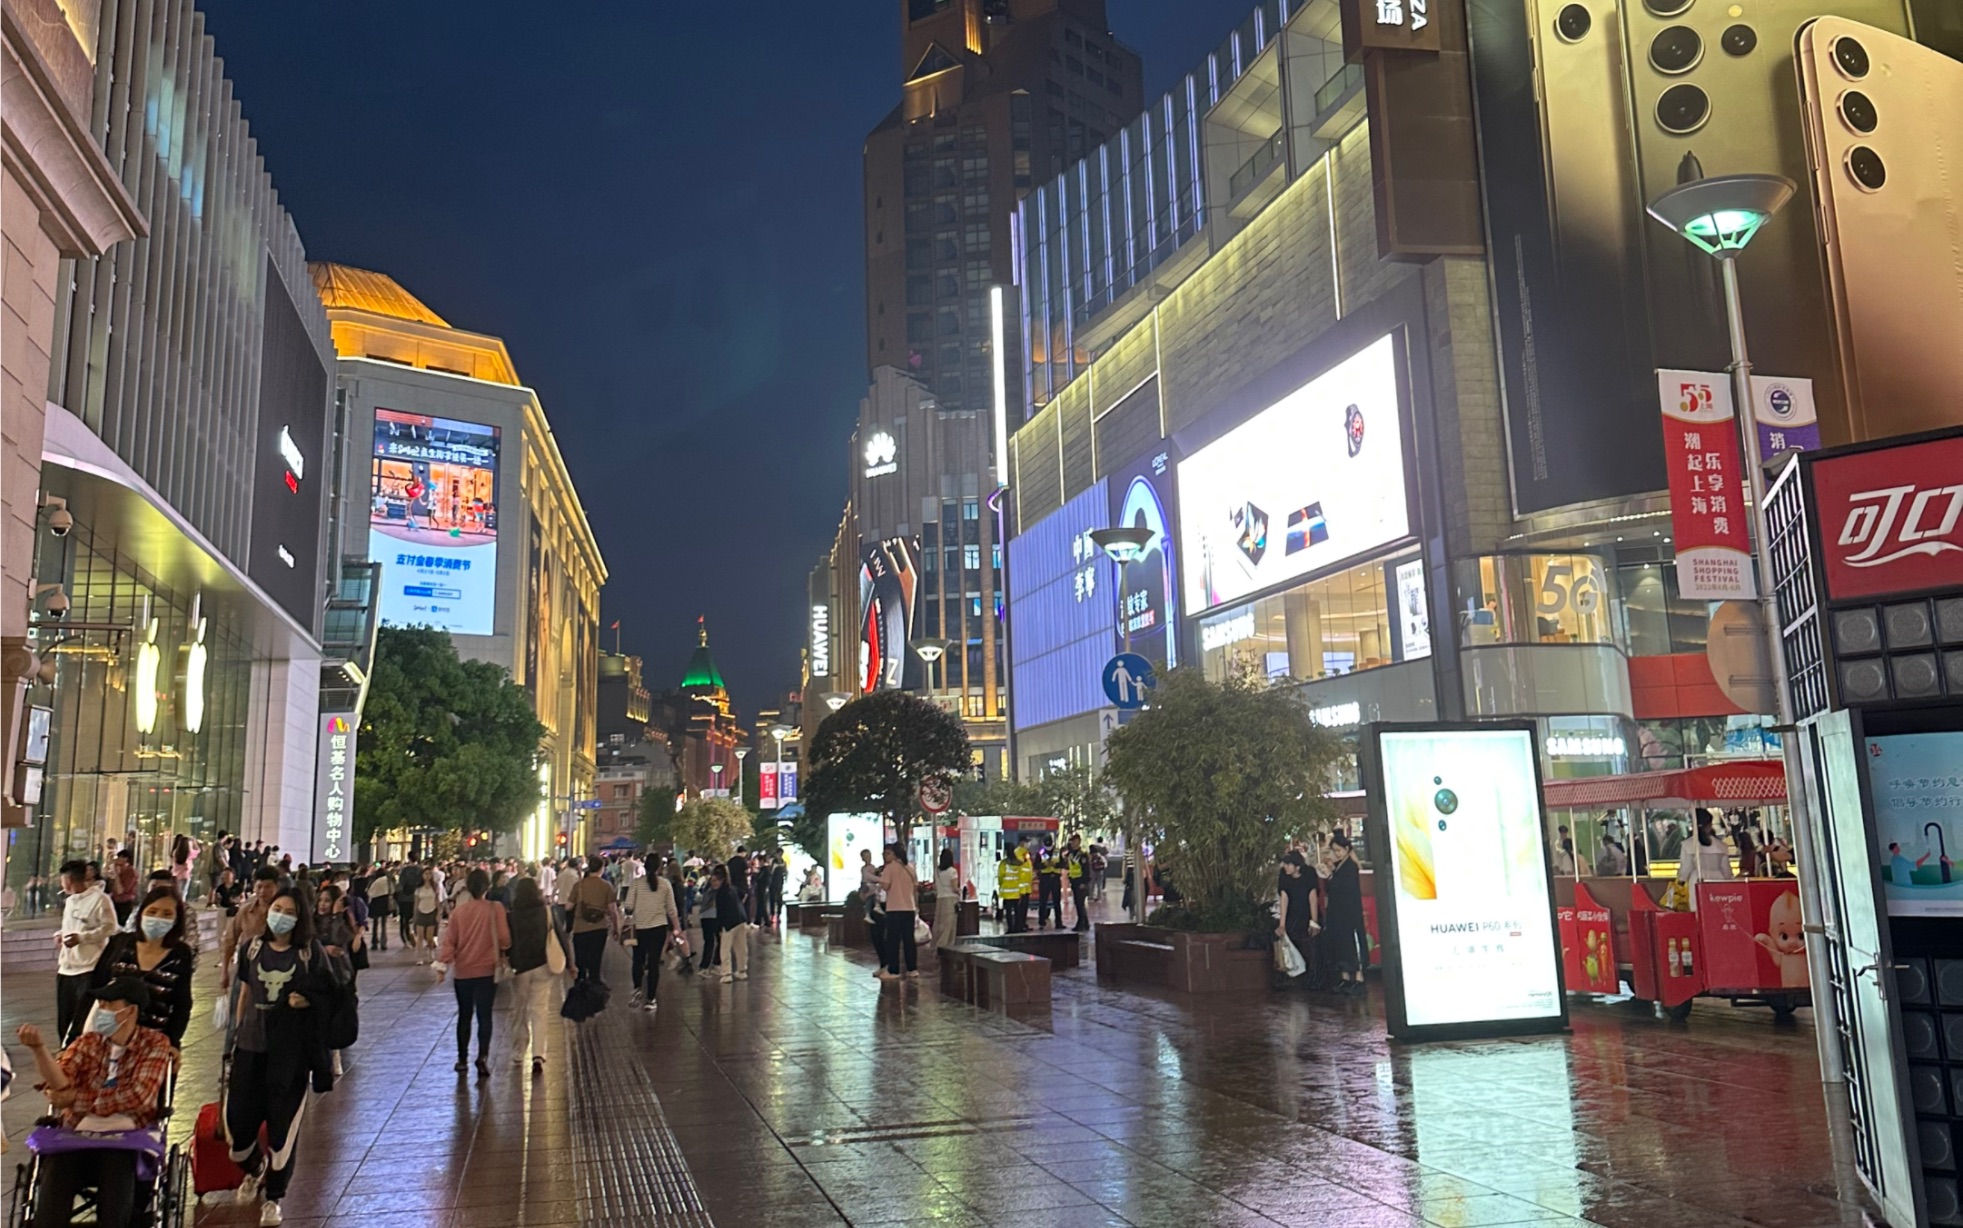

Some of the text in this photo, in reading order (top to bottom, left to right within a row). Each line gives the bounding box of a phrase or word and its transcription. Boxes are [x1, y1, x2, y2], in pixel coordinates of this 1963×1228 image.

[866, 462, 897, 478] HUAWEI
[1684, 432, 1708, 515] 潮起上海
[1705, 453, 1730, 535] 乐享消费
[1693, 558, 1738, 567] SHANGHAI
[1694, 567, 1739, 575] SHOPPING
[1537, 566, 1599, 614] 5G
[1695, 575, 1740, 583] FESTIVAL
[813, 605, 829, 677] HUAWEI
[1202, 612, 1256, 652] SAMSUNG
[1309, 701, 1361, 728] SAMSUNG
[1546, 737, 1625, 756] SAMSUNG
[324, 734, 347, 860] 恒基名人购物中心
[1709, 893, 1743, 903] kewpie
[1430, 922, 1479, 934] HUAWEI
[1482, 920, 1501, 932] P60
